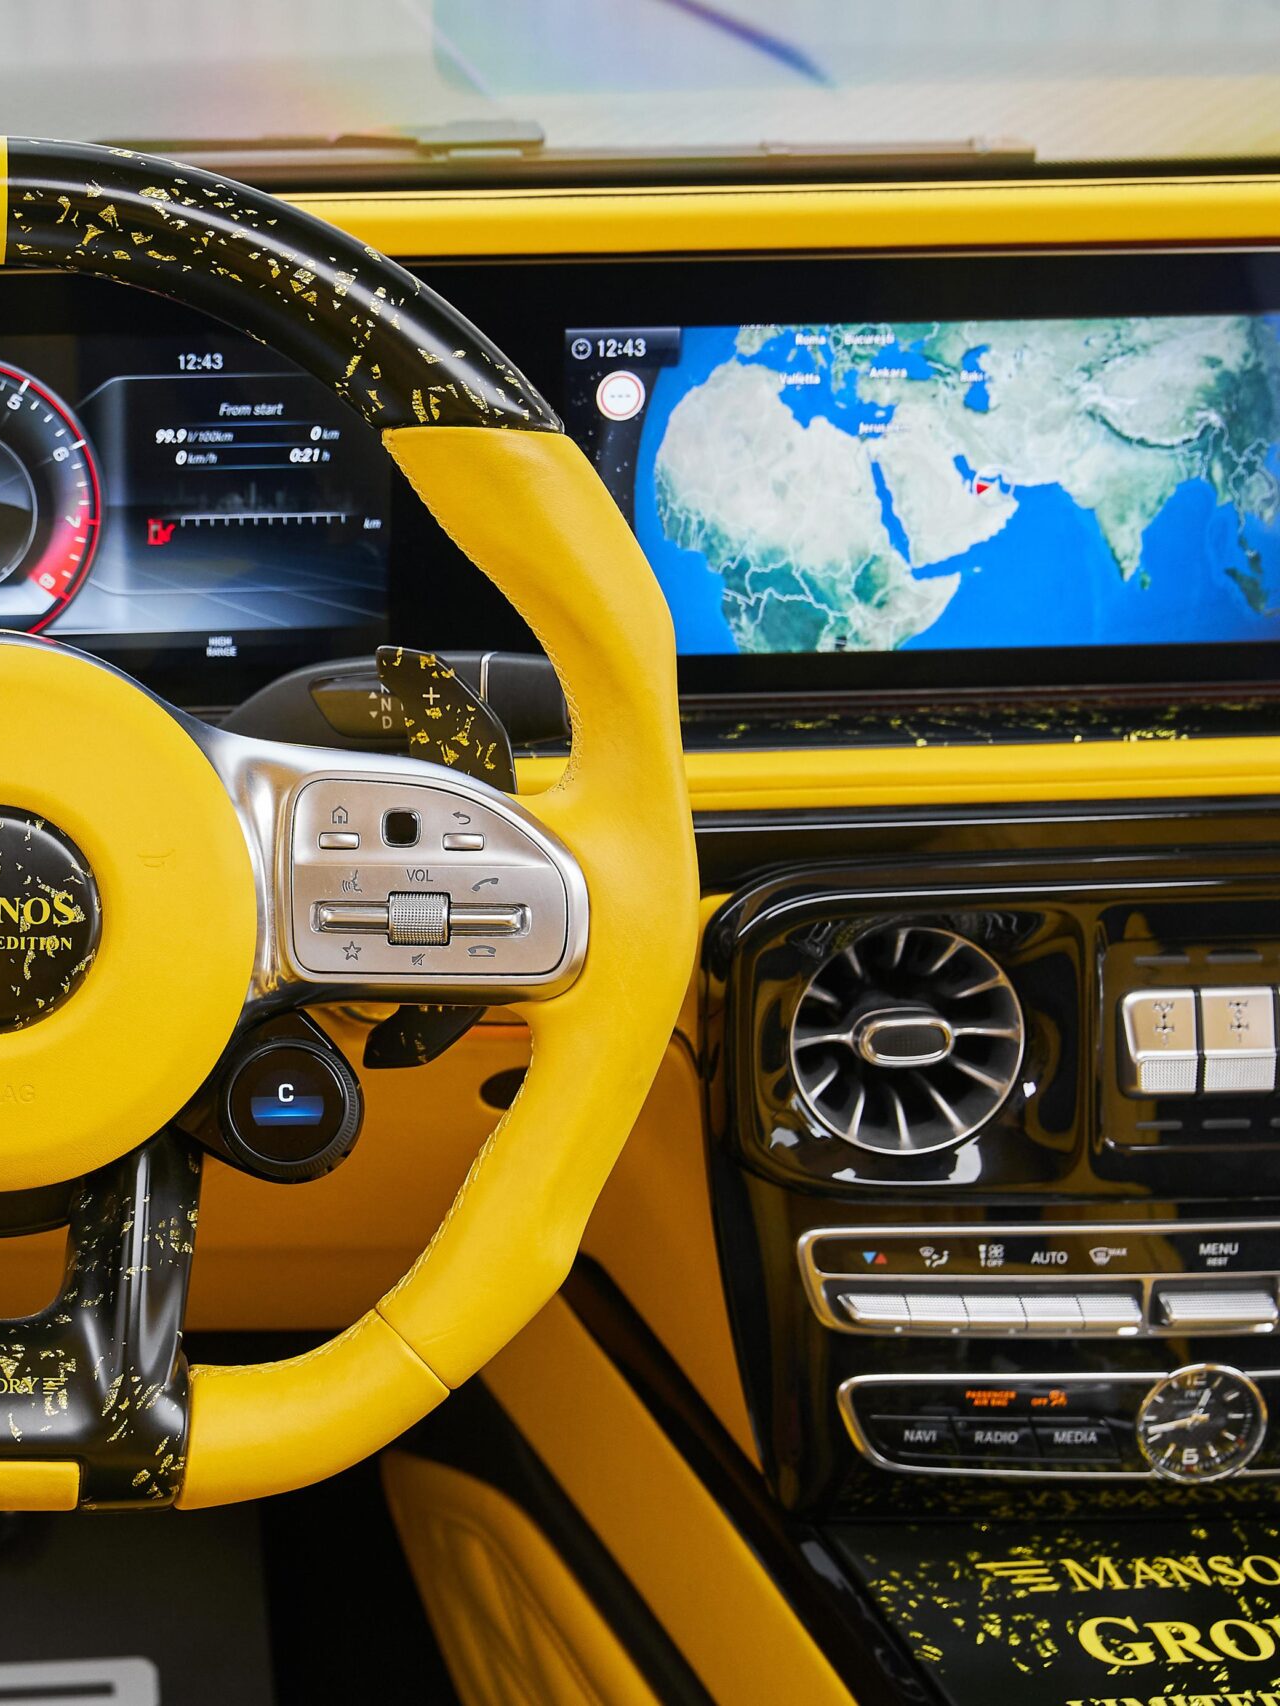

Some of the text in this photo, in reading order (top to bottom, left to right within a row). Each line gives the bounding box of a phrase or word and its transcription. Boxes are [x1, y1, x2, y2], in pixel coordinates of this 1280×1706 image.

[596, 338, 647, 358] 12:43
[178, 353, 224, 370] 12:43
[779, 372, 821, 385] Valletta
[869, 366, 908, 379] Ankara
[6, 393, 24, 411] 5
[219, 403, 284, 416] From start
[155, 428, 187, 444] 99.9
[310, 426, 340, 441] 0 km
[53, 446, 70, 462] 6
[175, 450, 187, 466] 0
[289, 448, 320, 463] 0:21
[65, 515, 81, 529] 7
[363, 518, 382, 530] km
[381, 697, 392, 712] N
[382, 716, 393, 729] D
[406, 869, 434, 882] VOL
[278, 1083, 294, 1102] C
[1199, 1242, 1240, 1256] MENU
[1031, 1251, 1069, 1264] AUTO
[903, 1429, 937, 1443] NAVI
[974, 1431, 1019, 1444] RADIO
[1053, 1431, 1098, 1444] MEDIA
[1181, 1448, 1200, 1465] 6
